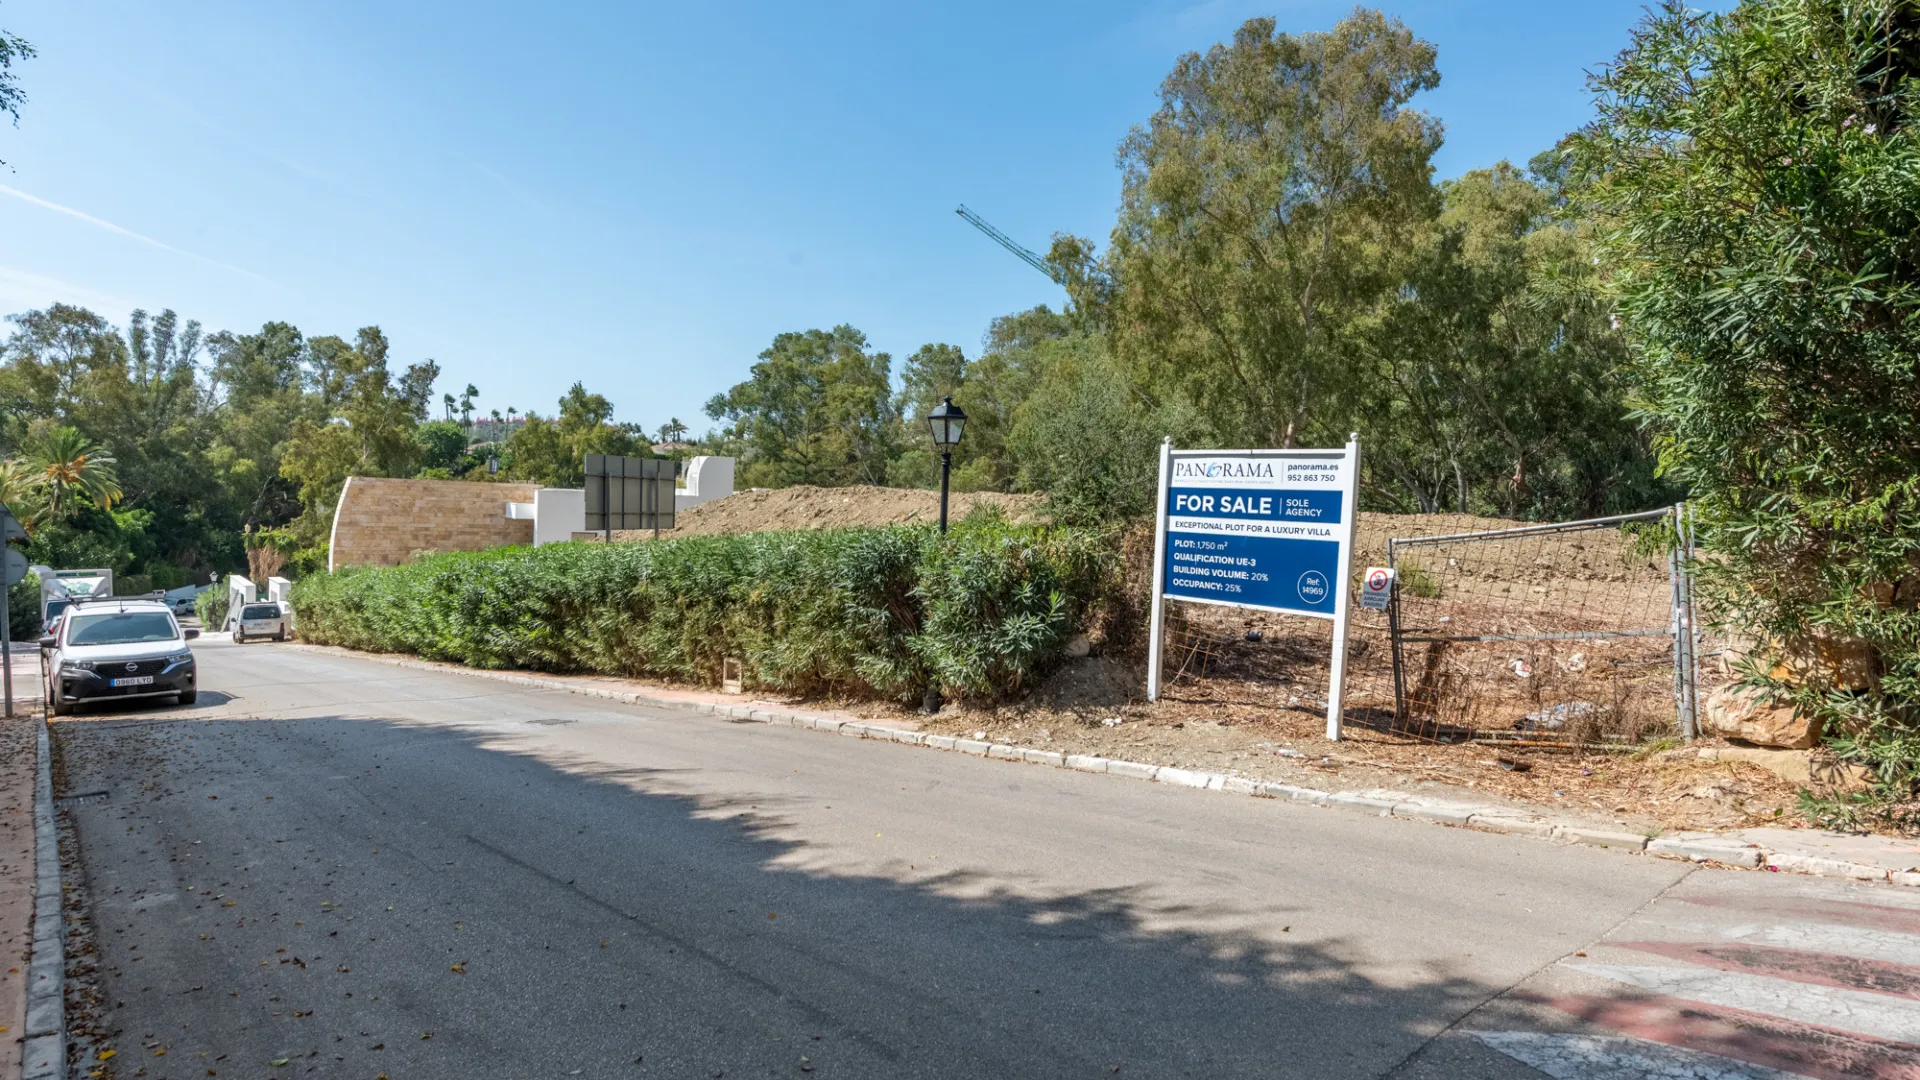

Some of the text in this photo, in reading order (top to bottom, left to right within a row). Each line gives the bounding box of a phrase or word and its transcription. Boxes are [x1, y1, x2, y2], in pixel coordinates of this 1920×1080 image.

[1287, 464, 1339, 472] panorama.es
[1287, 474, 1336, 482] 952 863 750
[1176, 494, 1272, 515] FOR SALE
[1285, 498, 1309, 507] SOLE
[1285, 508, 1322, 517] AGENCY
[1175, 520, 1331, 536] EXCEPTIONAL PLOT FOR A LUXURY VILLA
[1174, 539, 1196, 548] PLOT:
[1173, 552, 1256, 567] QUALIFICATION UE-3
[1173, 565, 1269, 582] BUILDING VOLUME: 20%
[1172, 578, 1242, 593] OCCUPANCY: 25%
[1302, 586, 1324, 596] 14969
